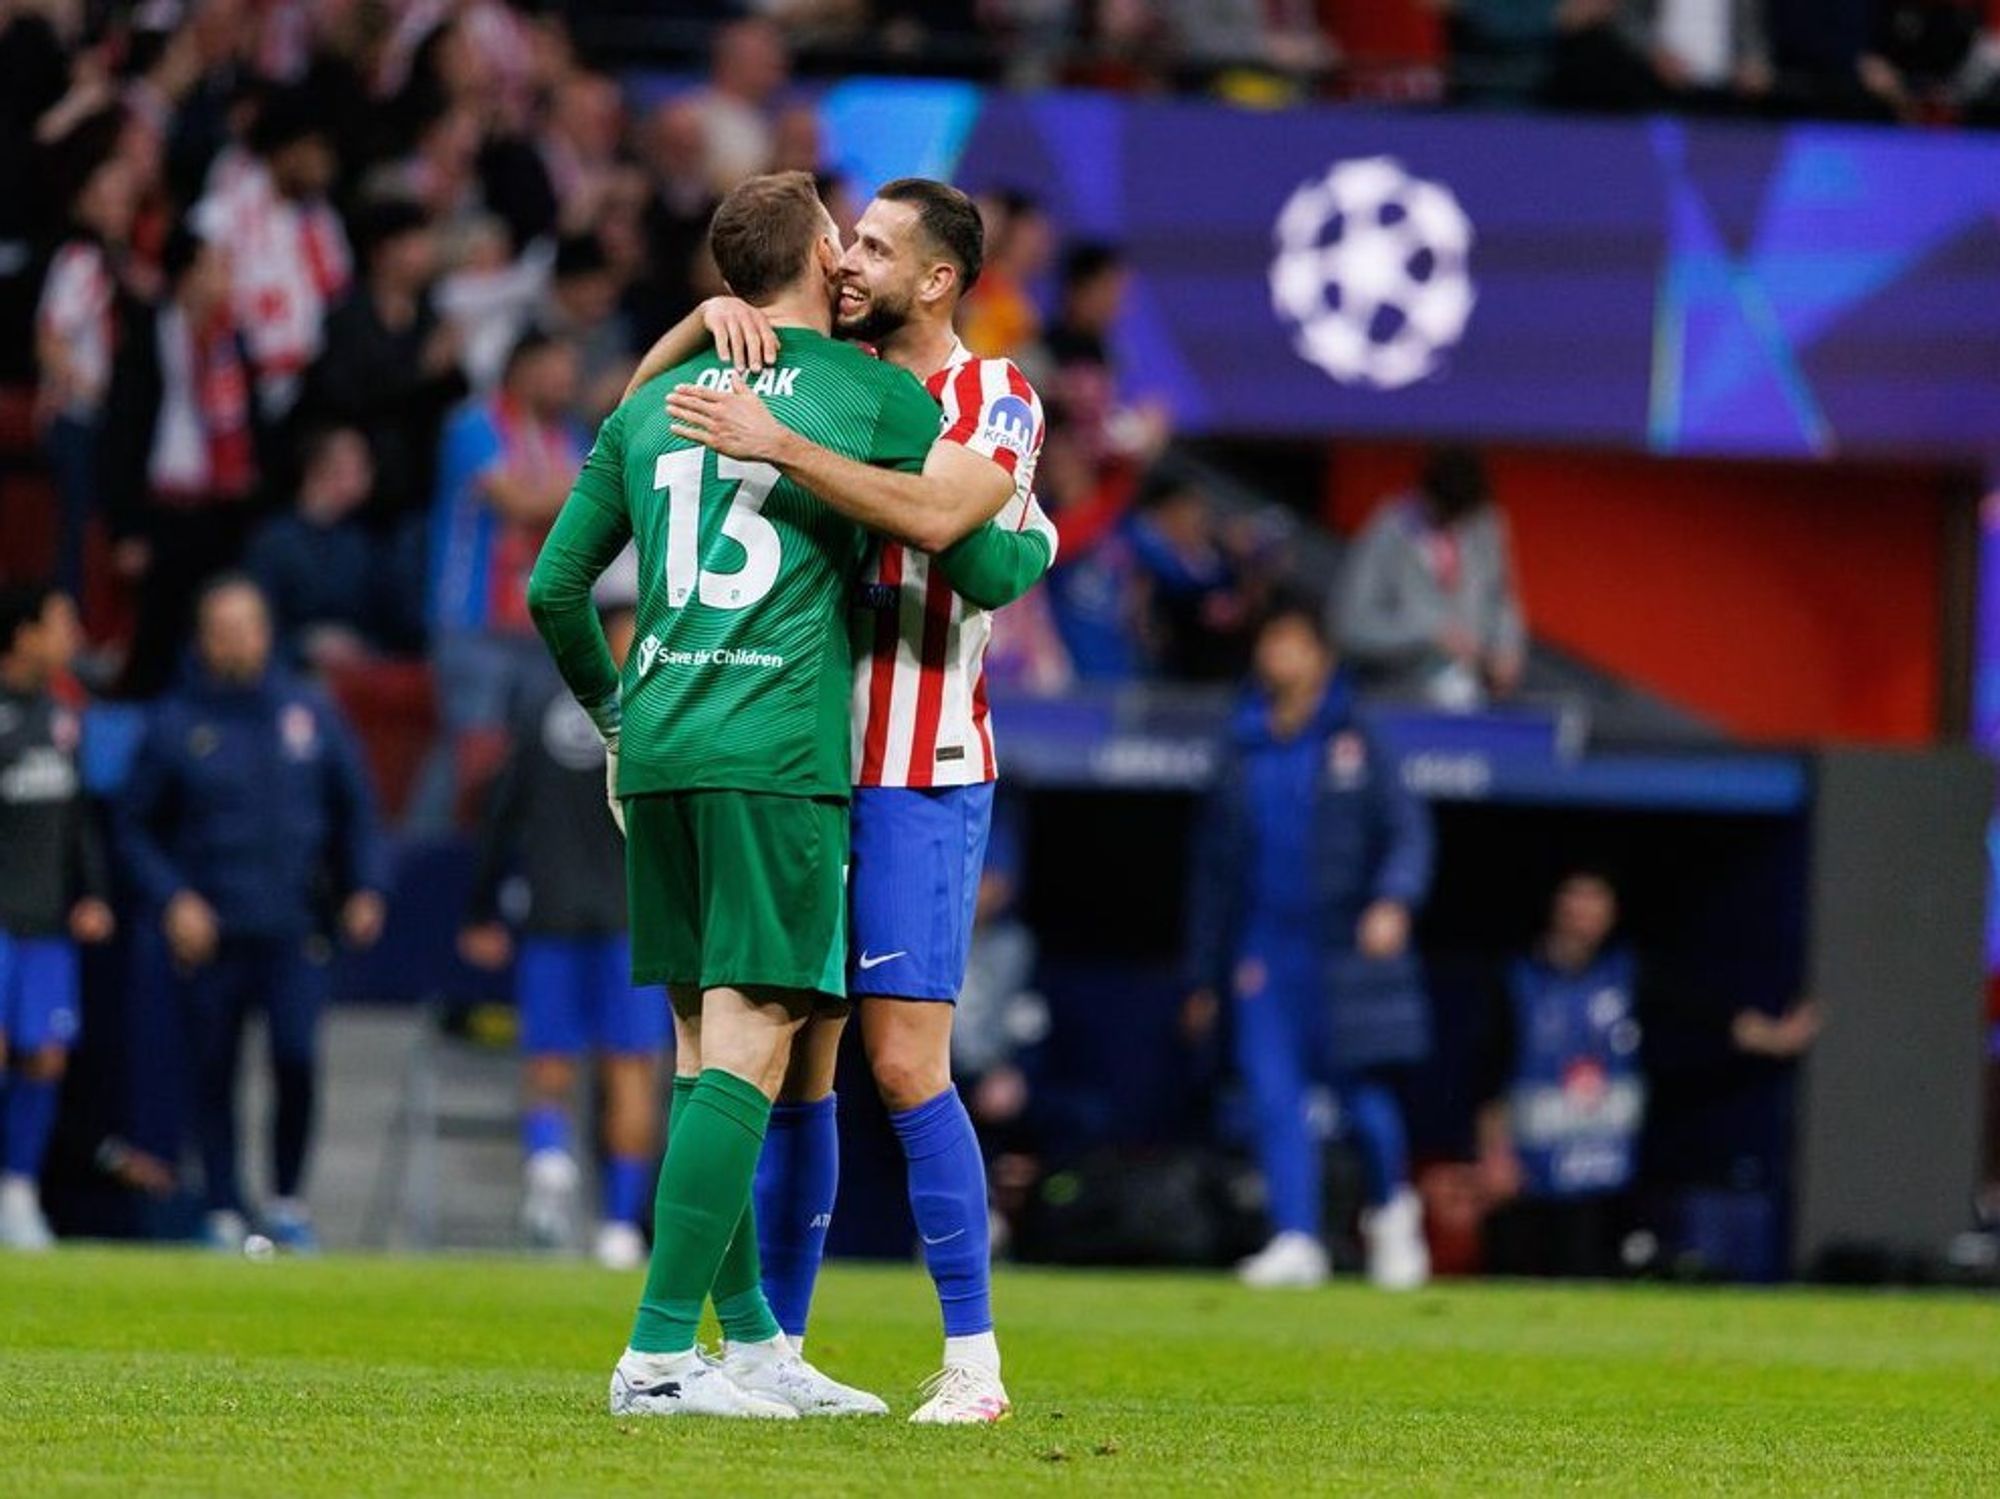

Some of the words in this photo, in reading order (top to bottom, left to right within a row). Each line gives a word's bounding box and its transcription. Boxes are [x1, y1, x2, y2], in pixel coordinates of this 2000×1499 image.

[697, 367, 802, 397] OBAK
[653, 445, 782, 610] 13
[658, 647, 692, 665] Save
[713, 649, 784, 668] Children
